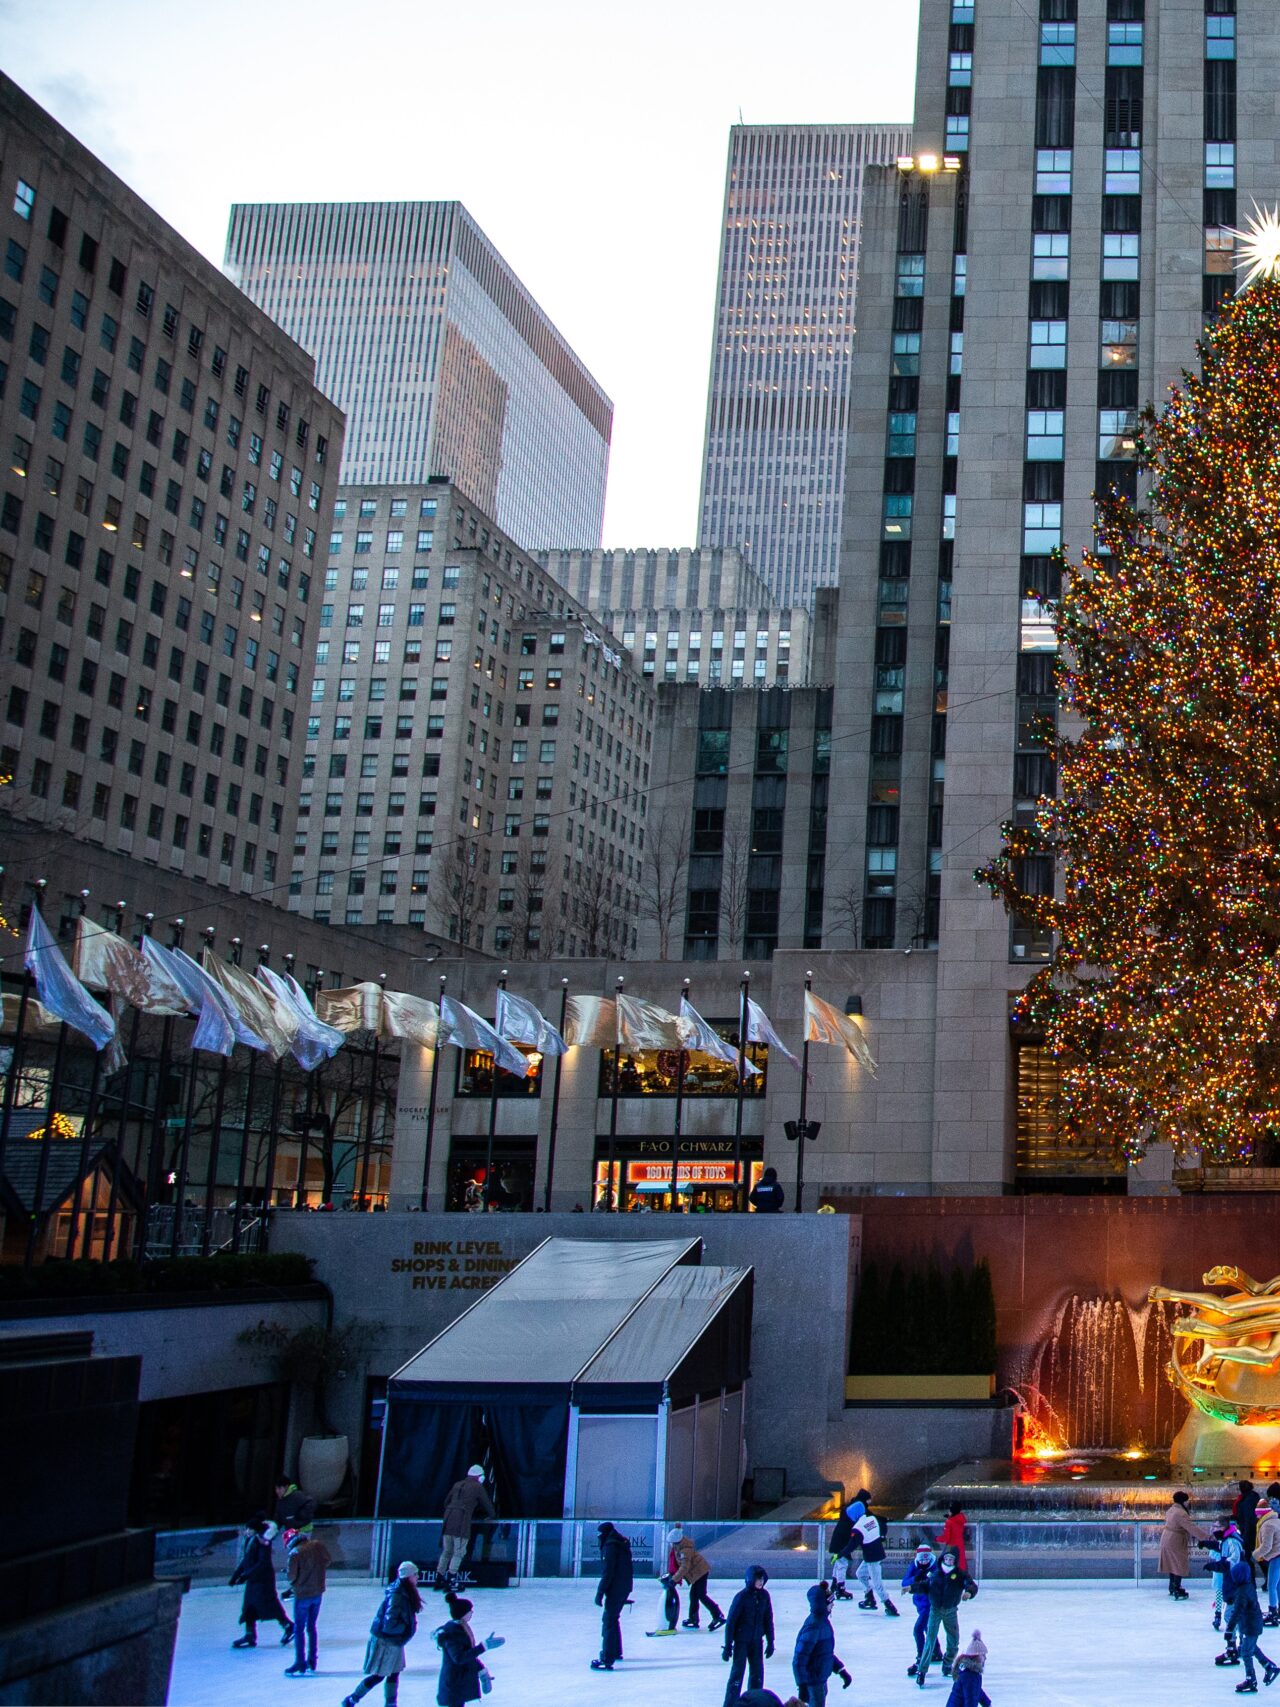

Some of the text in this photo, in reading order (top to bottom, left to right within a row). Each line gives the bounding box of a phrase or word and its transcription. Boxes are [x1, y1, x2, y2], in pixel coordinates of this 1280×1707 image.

[677, 1141, 733, 1152] CHWARZ
[646, 1166, 662, 1179] 160
[692, 1166, 703, 1179] OF
[704, 1166, 726, 1179] TOYS
[413, 1241, 503, 1255] RINK LEVEL
[391, 1259, 445, 1272] SHOPS
[448, 1258, 460, 1272] &
[412, 1276, 448, 1289] FIVE
